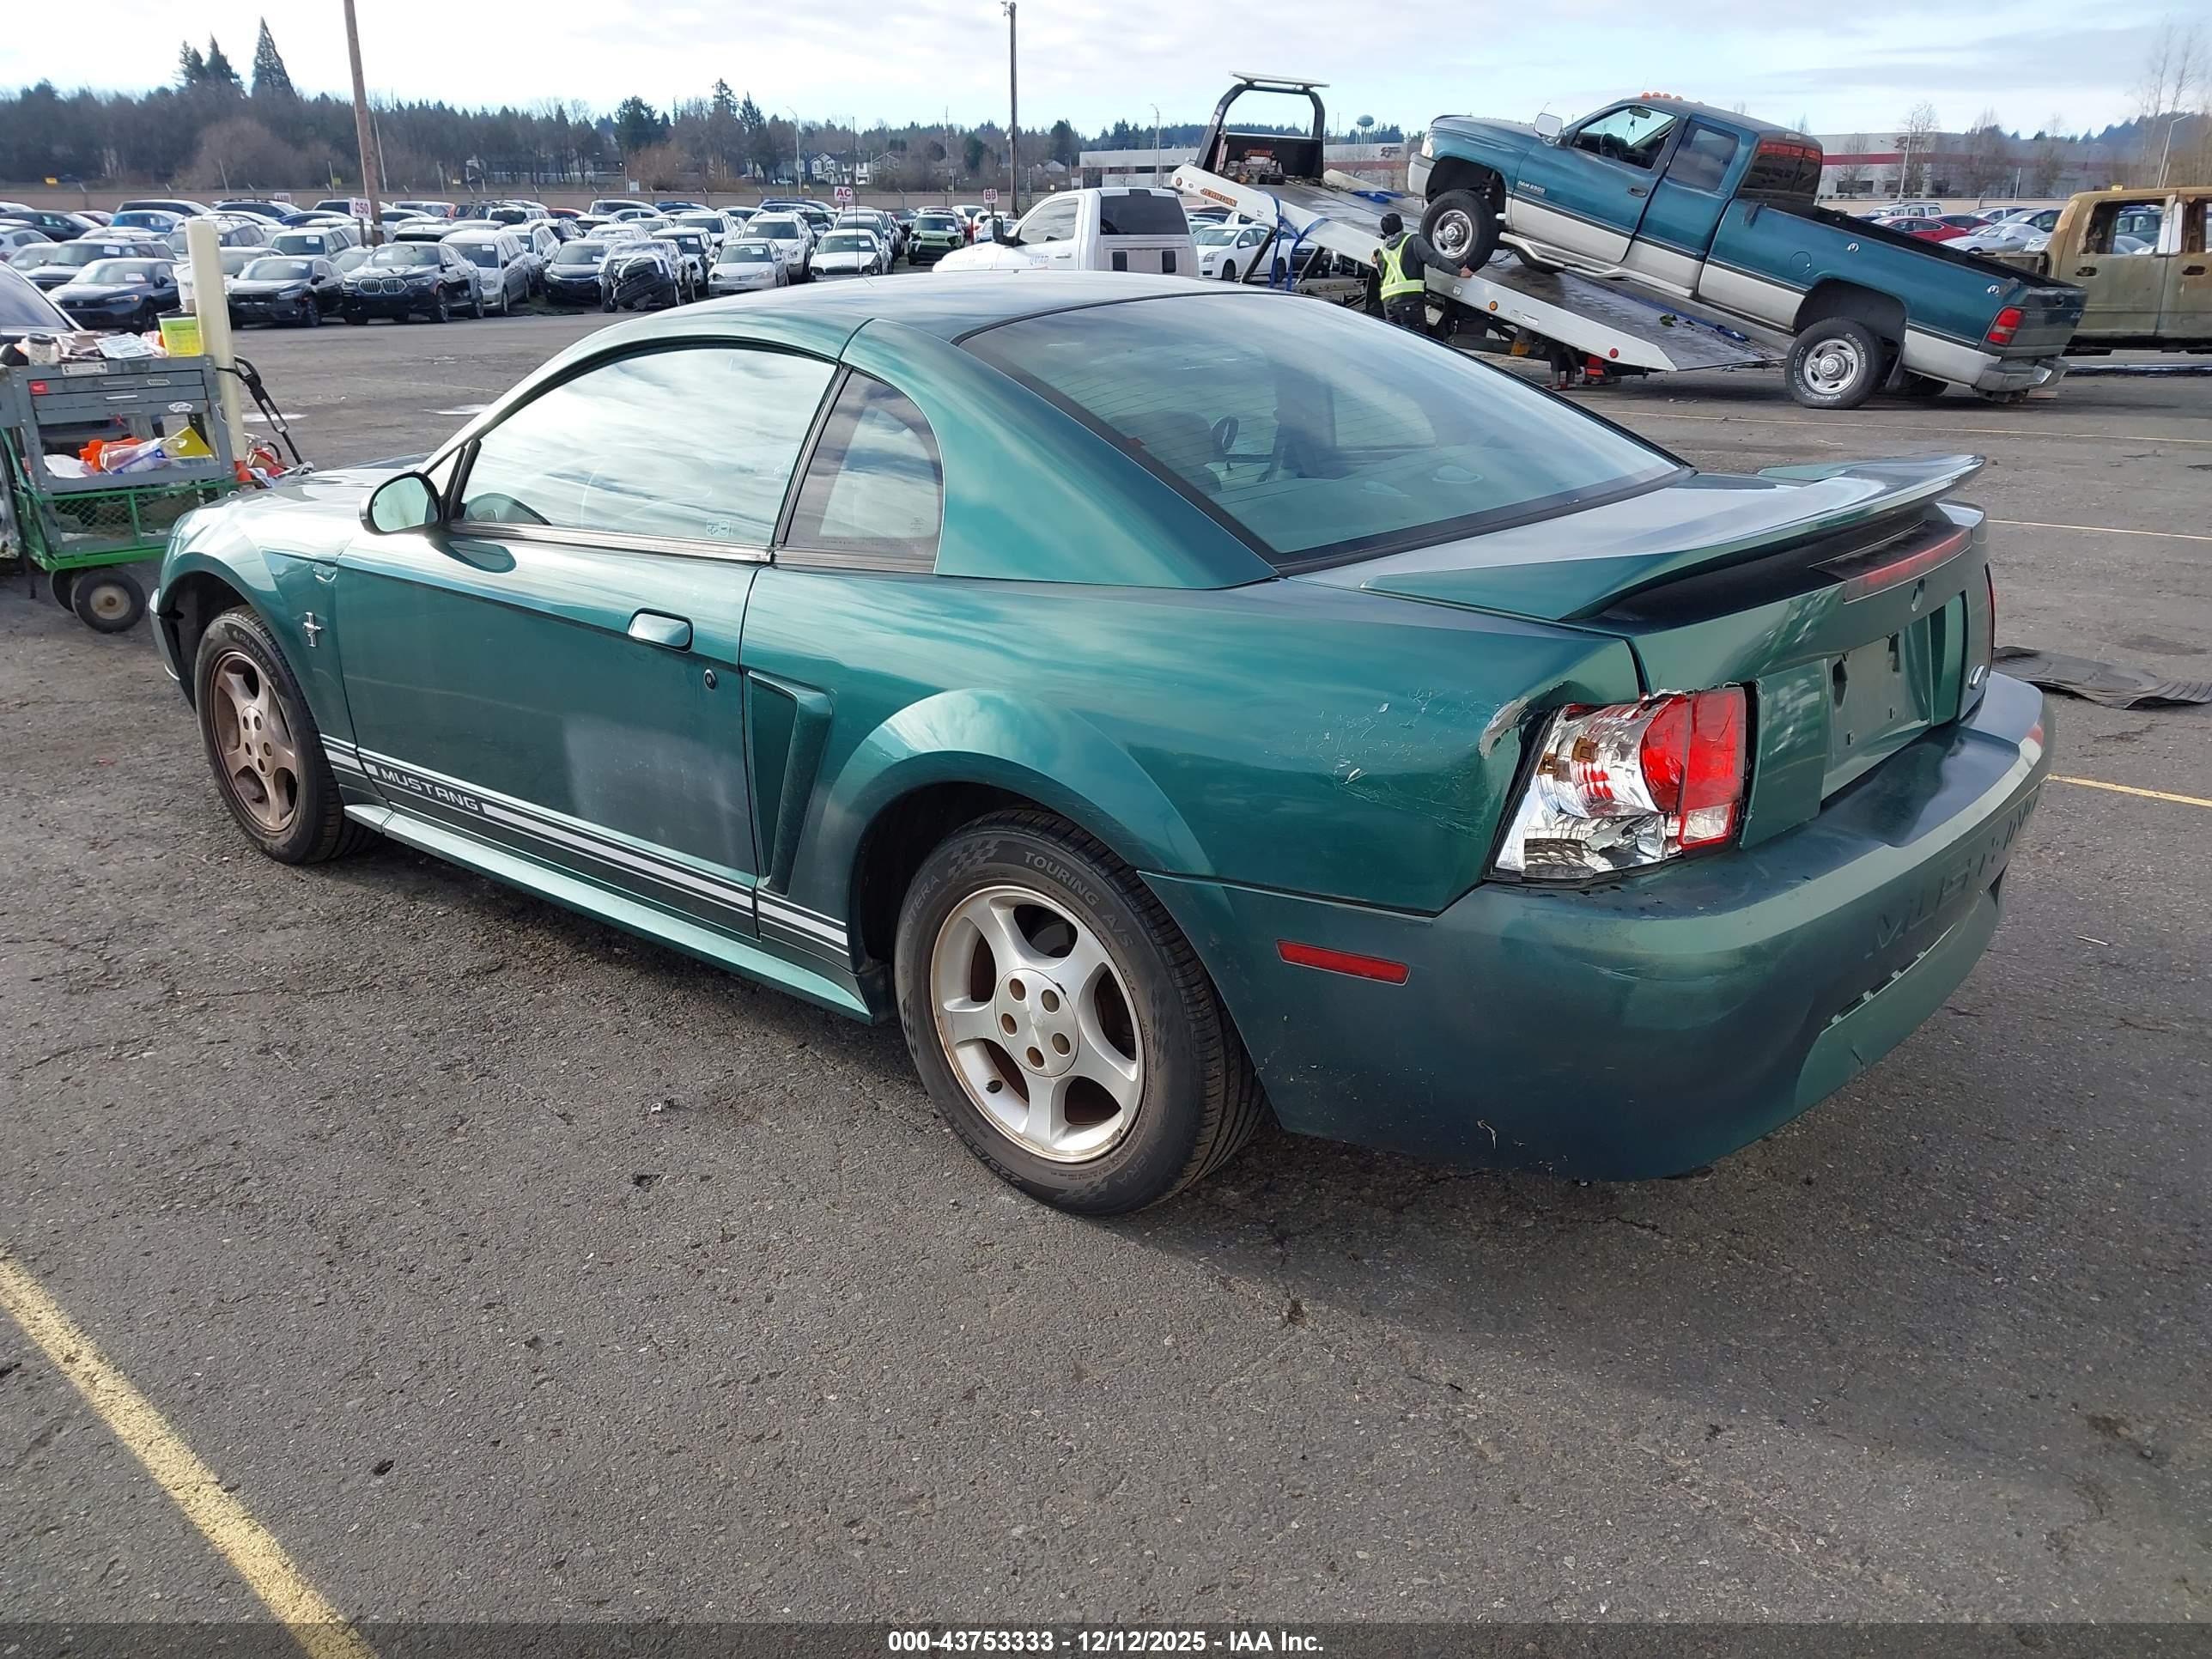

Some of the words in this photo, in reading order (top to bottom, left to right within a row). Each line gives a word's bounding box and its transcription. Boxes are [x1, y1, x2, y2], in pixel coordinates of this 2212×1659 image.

[836, 188, 852, 198] AC
[380, 768, 479, 811] MUSTANG
[1023, 851, 1101, 907] TOURING
[1101, 913, 1134, 947] A/S
